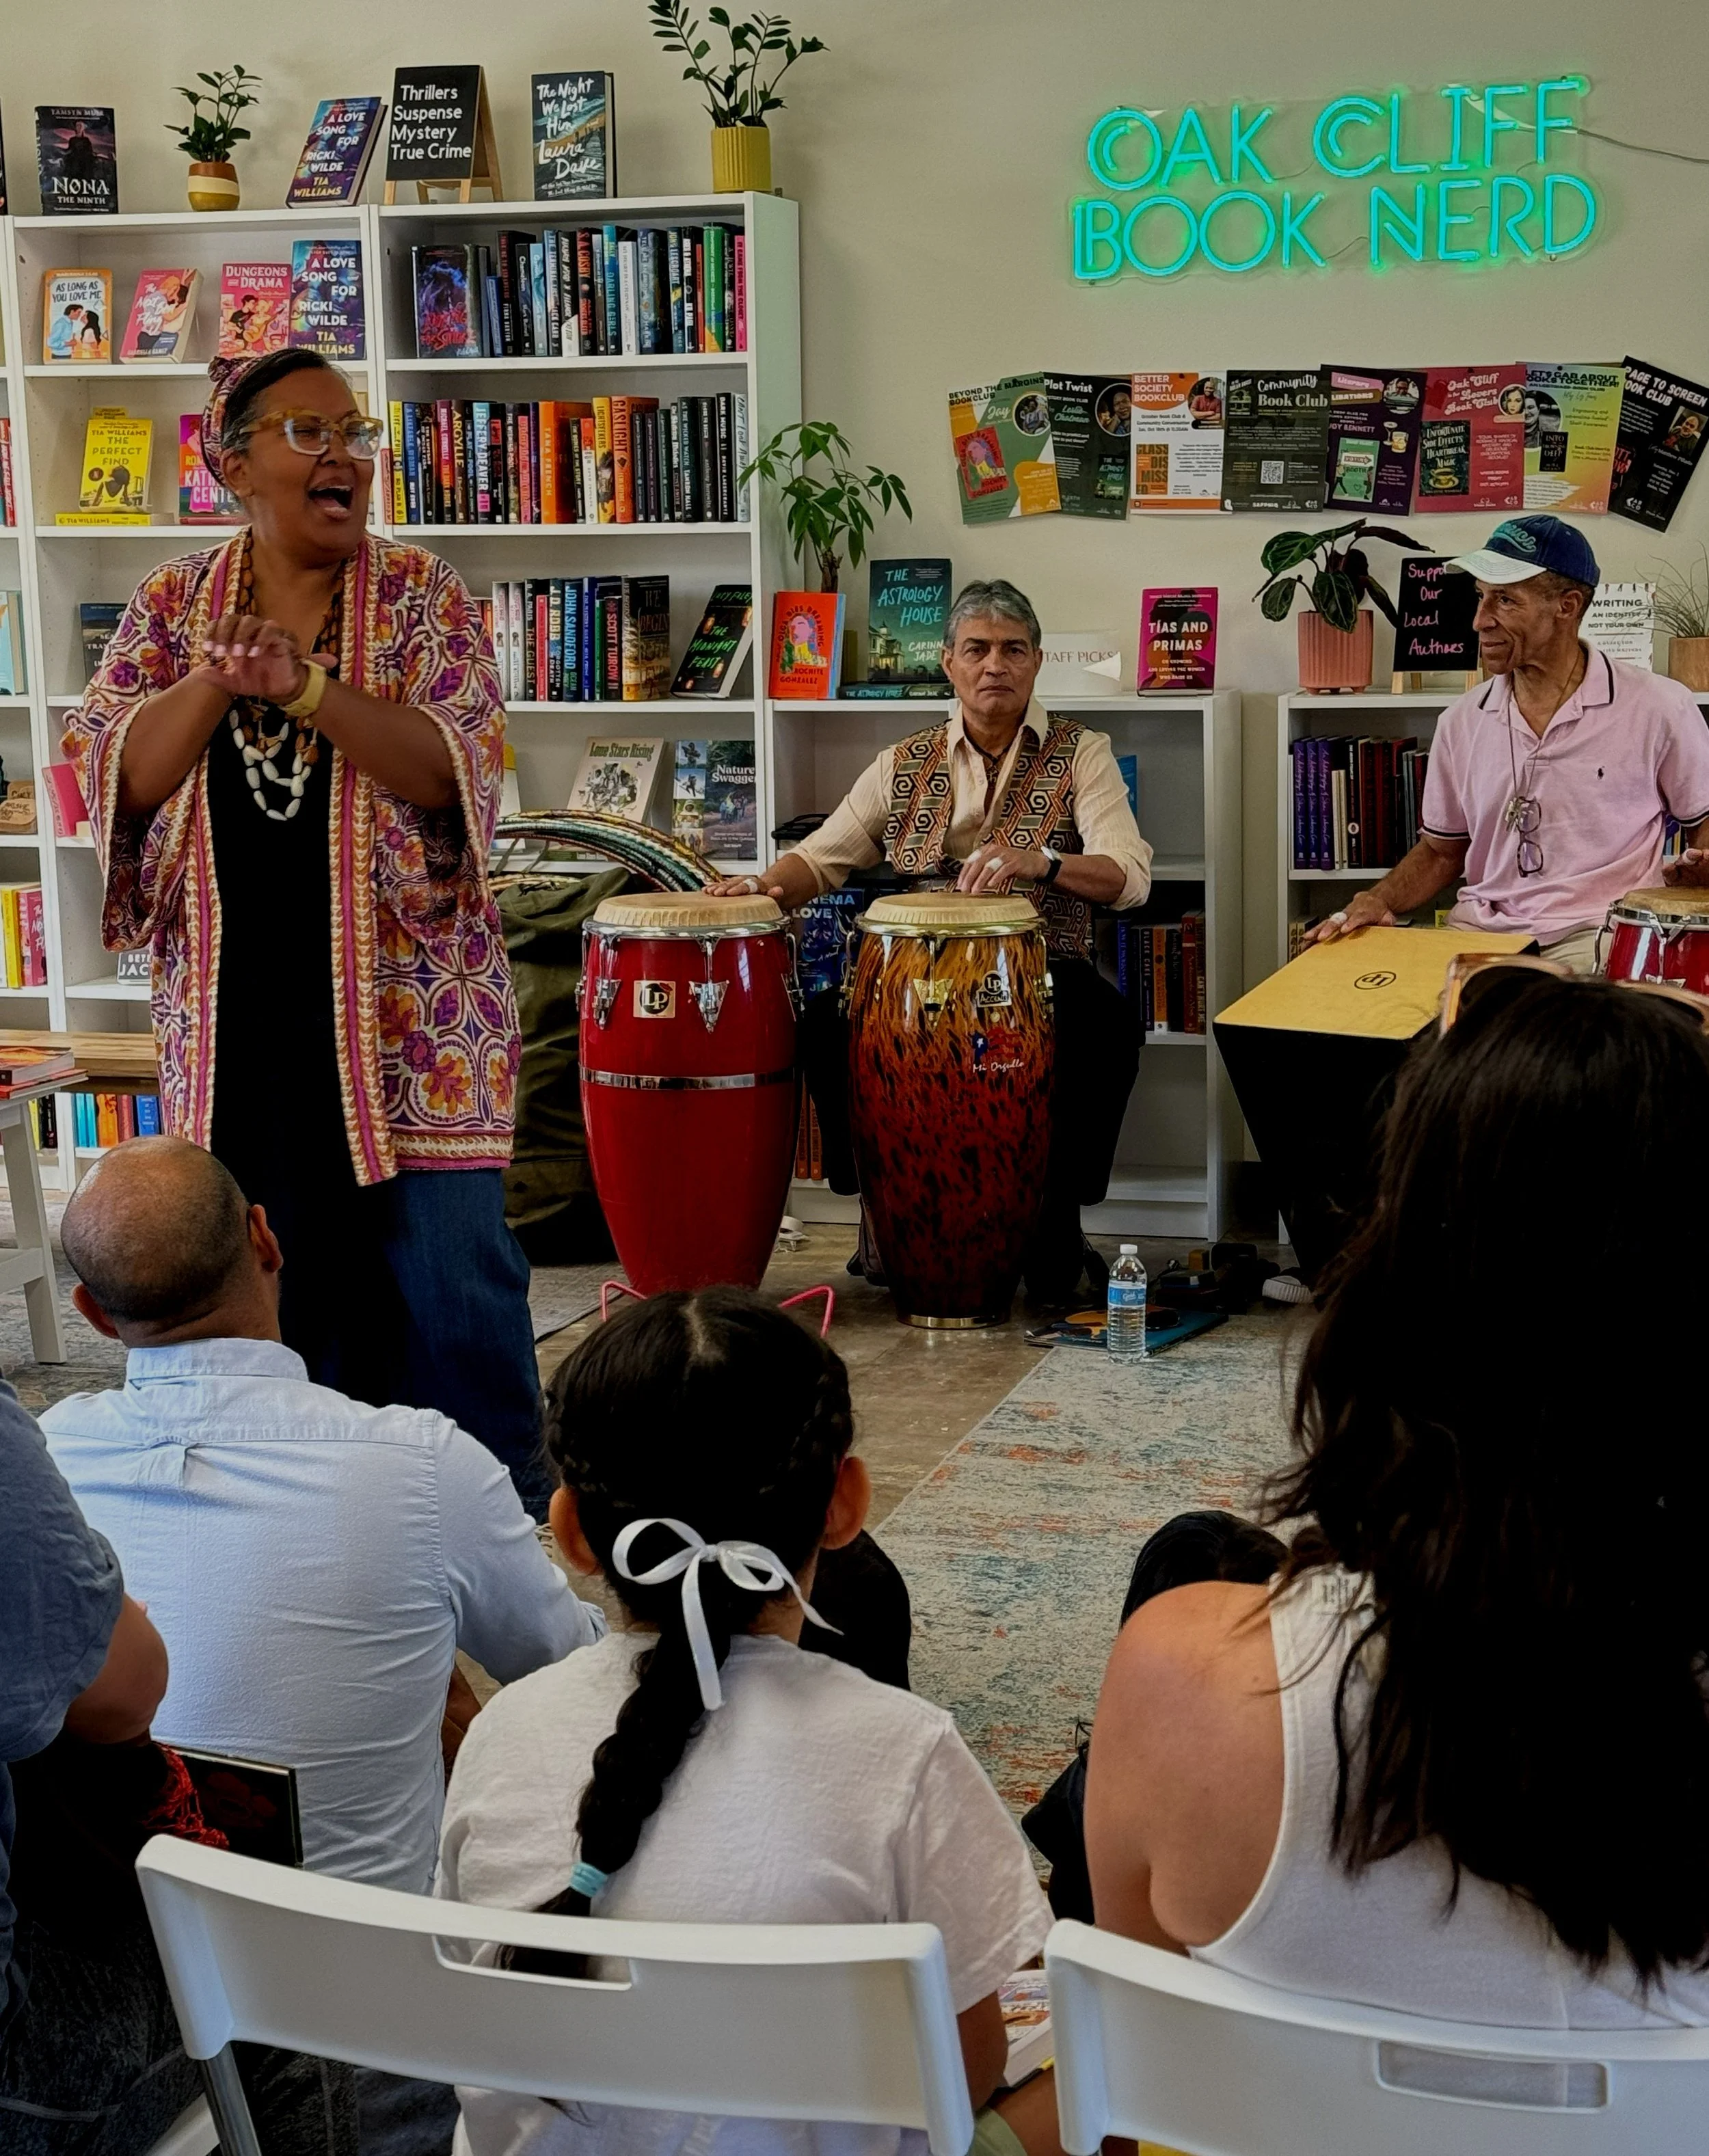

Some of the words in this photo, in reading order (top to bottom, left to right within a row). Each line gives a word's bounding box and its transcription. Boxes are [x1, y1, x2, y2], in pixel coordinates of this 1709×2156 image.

[400, 84, 459, 101] Thrillers
[536, 83, 556, 100] The
[558, 77, 595, 101] Night
[394, 105, 463, 123] Suspense
[541, 100, 560, 116] We
[560, 97, 587, 119] Lost
[327, 115, 336, 124] A
[338, 112, 366, 122] LOVE
[316, 125, 347, 135] SONG
[391, 124, 457, 144] Mystery
[1087, 105, 1274, 191] OAK
[1313, 81, 1580, 178] CLIFF
[336, 137, 360, 146] FOR
[306, 150, 336, 161] RICKI
[390, 144, 425, 161] True
[427, 143, 472, 159] Crime
[538, 139, 585, 165] Laura
[310, 162, 345, 172] WILDE
[555, 158, 602, 180] Dave
[313, 176, 329, 185] TIA
[293, 187, 342, 198] WILLIAMS
[1074, 190, 1326, 280] BOOK
[1371, 174, 1596, 265] NERD
[578, 230, 590, 249] S.A.
[311, 258, 321, 268] A
[323, 258, 355, 268] LOVE
[579, 250, 591, 278] COSBY
[671, 249, 680, 284] LESCROART
[225, 265, 288, 278] DUNGEONS
[301, 271, 337, 282] SONG
[56, 282, 65, 293] AS
[67, 282, 88, 291] LONG
[88, 280, 99, 291] AS
[240, 277, 284, 291] DRAMA
[331, 286, 358, 296] FOR
[606, 272, 615, 308] DARLING
[52, 293, 68, 303] YOU
[68, 292, 88, 301] LOVE
[89, 291, 103, 299] ME
[299, 301, 333, 312] RICKI
[308, 315, 348, 326] WILDE
[317, 332, 336, 342] TIA
[1134, 375, 1169, 383] BETTER
[1257, 374, 1318, 392] Community
[1447, 378, 1470, 390] Oak
[1470, 373, 1500, 386] Cliff
[1559, 377, 1619, 388] TOGETHER!
[1580, 373, 1619, 381] ABOUT
[948, 388, 983, 399] BEYOND
[986, 384, 1002, 393] THE
[1004, 377, 1045, 390] MARGINS
[1044, 378, 1064, 390] Plot
[1064, 380, 1094, 393] Twist
[1134, 384, 1173, 392] SOCIETY
[1624, 366, 1651, 384] PAGE
[1653, 377, 1668, 389] TO
[1669, 383, 1709, 407] SCREEN
[949, 392, 996, 407] BOOKCLUB
[1134, 393, 1185, 402] BOOKCLUB
[1258, 394, 1293, 407] Book
[1295, 394, 1328, 407] Club
[1460, 388, 1498, 401] Lovers
[1624, 381, 1645, 395] OOK
[1645, 386, 1673, 407] CLUB
[1444, 402, 1472, 415] Book
[1472, 398, 1498, 409] Club
[475, 408, 487, 450] JEFFERY
[597, 406, 606, 448] LIGHTSEEKERS
[613, 400, 628, 453] GASLIGHT
[441, 433, 449, 460] CONNELLY
[453, 410, 464, 468] ARGYLLE
[92, 447, 142, 455] PERFECT
[1426, 446, 1466, 459] HEARTBREAK
[102, 457, 129, 466] FIND
[1150, 457, 1168, 468] DIS
[477, 453, 489, 490] DEAVER
[1141, 470, 1168, 483] MISS
[193, 487, 235, 503] CENTE
[885, 569, 909, 582] THE
[1408, 563, 1445, 582] Suppo
[550, 585, 561, 607] J.D.
[565, 585, 576, 614] JOHN
[878, 585, 943, 607] ASTROLOGY
[1421, 586, 1442, 601] Our
[786, 604, 804, 617] DIES
[900, 606, 943, 628] HOUSE
[550, 609, 561, 640] ROBB
[807, 605, 824, 647] DREAMING
[1148, 619, 1177, 634] TÍAS
[1181, 621, 1209, 633] AND
[1404, 610, 1439, 628] Local
[607, 613, 618, 645] SCOTT
[710, 626, 729, 636] THE
[527, 628, 535, 647] THE
[565, 616, 577, 669] SANDFORD
[1153, 639, 1202, 651] PRIMAS
[688, 639, 737, 652] MIDNIGHT
[1408, 638, 1464, 655] Authors
[688, 656, 722, 669] FEAST
[913, 650, 937, 662] JADE
[1044, 651, 1075, 662] TAFF
[527, 651, 535, 685] GUEST
[607, 647, 619, 681] TUROW
[779, 676, 818, 684] GONZALEZ
[857, 688, 885, 698] ASTROLOGY
[589, 742, 609, 757] Lone
[609, 742, 629, 758] Stars
[630, 743, 656, 762] Rising
[716, 764, 755, 774] Nature
[807, 894, 854, 905] NEMA
[792, 908, 833, 919] LOVE
[986, 977, 1001, 991] LP
[643, 987, 669, 1010] LP
[973, 1062, 987, 1073] Mi
[991, 1058, 1025, 1073] Orgullo
